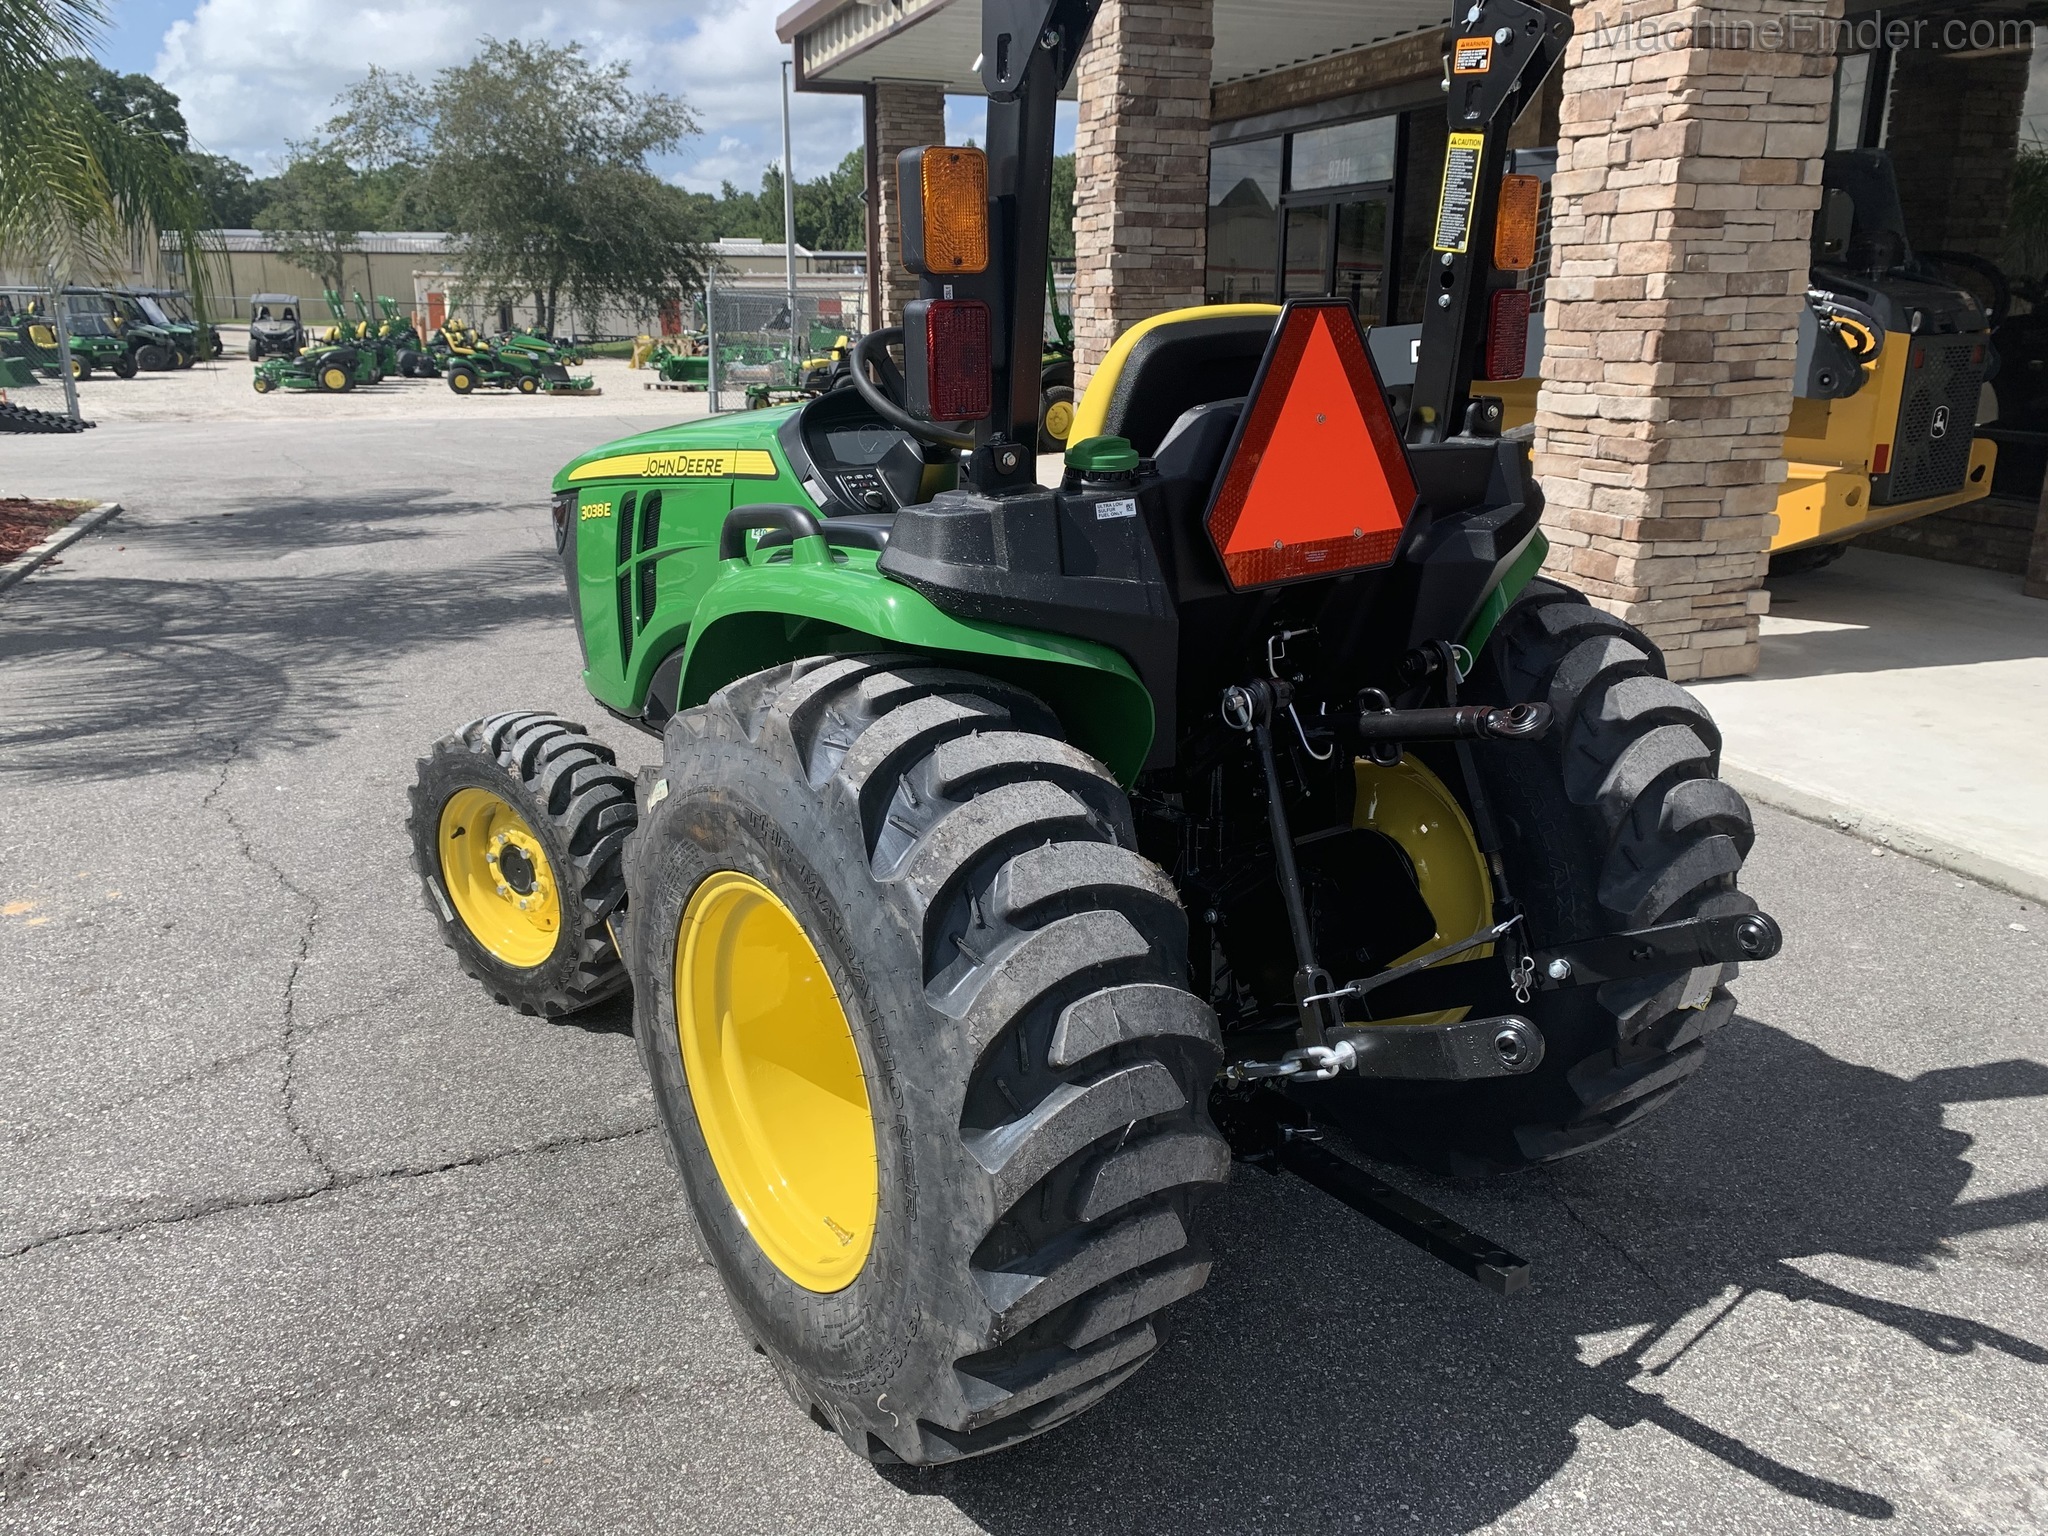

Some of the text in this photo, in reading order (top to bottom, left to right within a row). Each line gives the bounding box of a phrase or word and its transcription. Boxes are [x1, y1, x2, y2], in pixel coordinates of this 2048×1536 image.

[1465, 40, 1490, 48] WARNING
[1457, 138, 1482, 147] CAUTION
[642, 455, 724, 475] JOHN DEERE
[581, 502, 612, 521] 3038E
